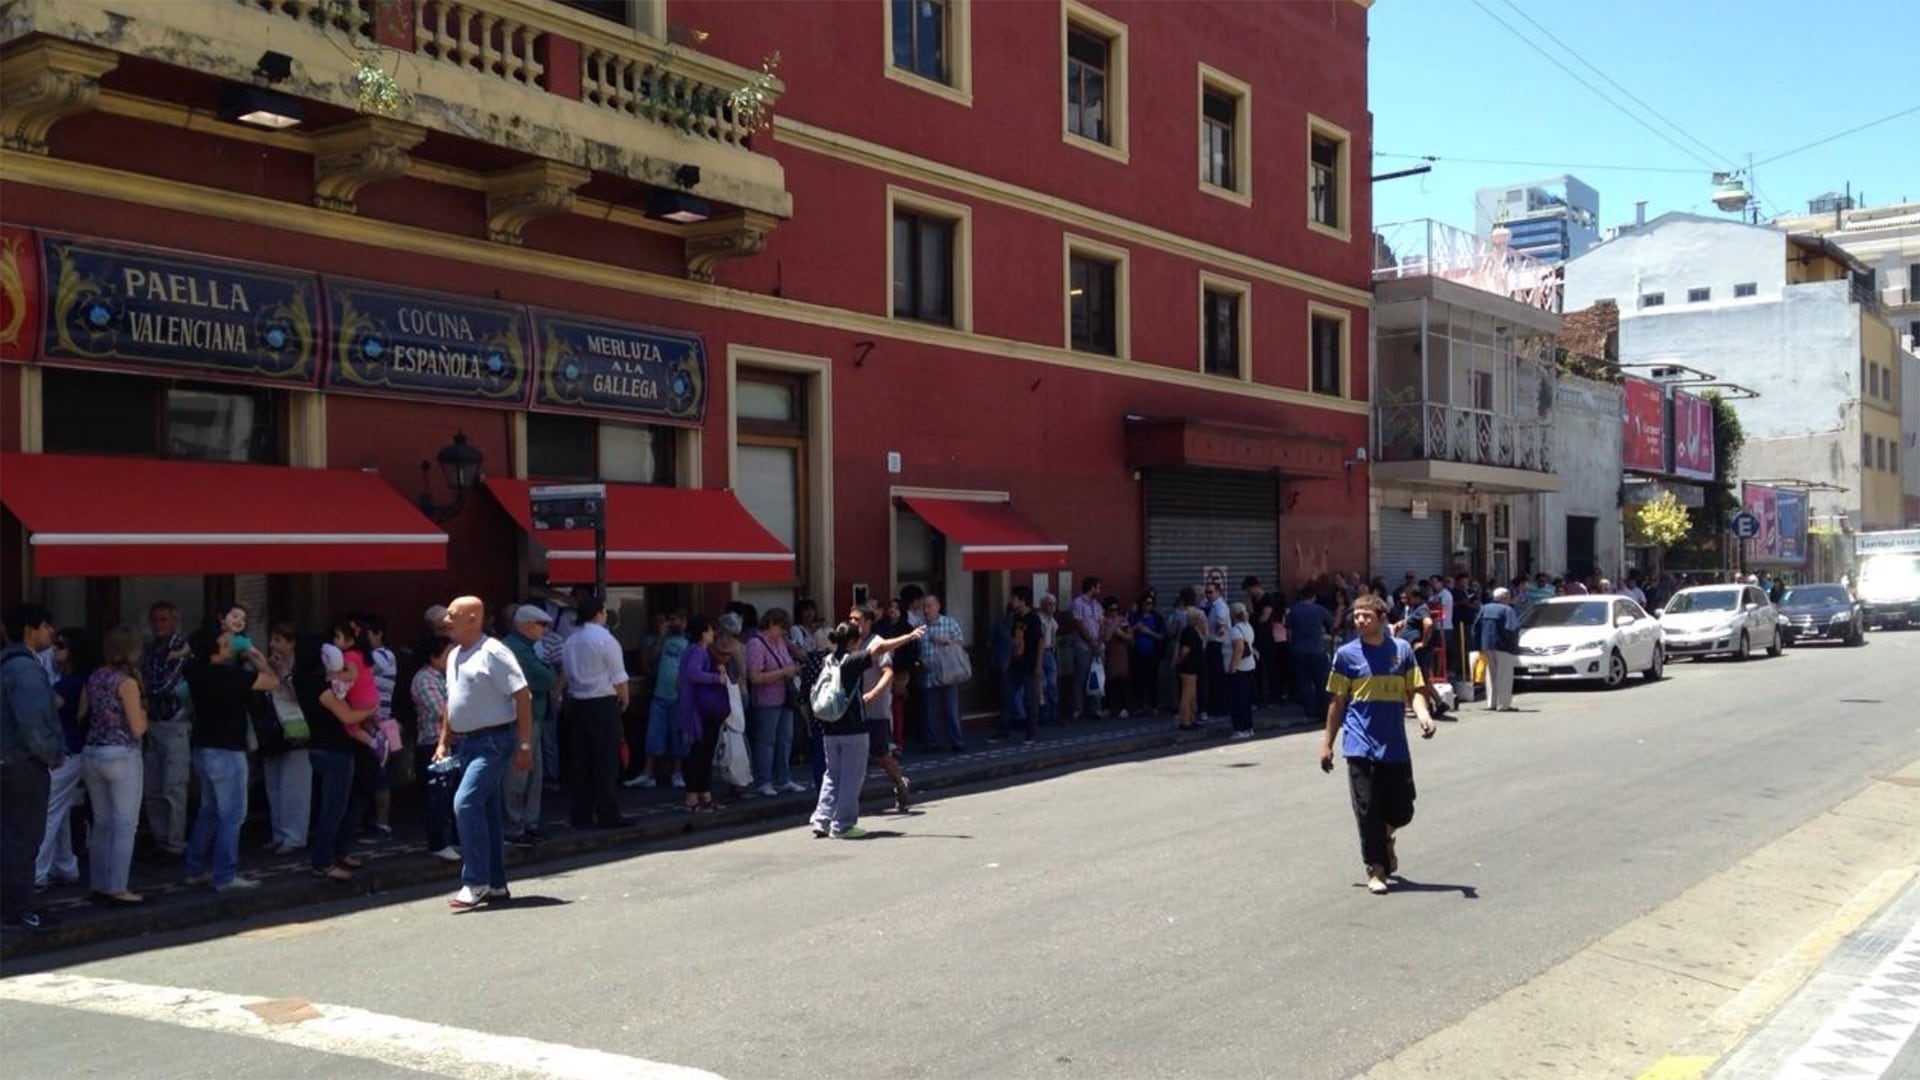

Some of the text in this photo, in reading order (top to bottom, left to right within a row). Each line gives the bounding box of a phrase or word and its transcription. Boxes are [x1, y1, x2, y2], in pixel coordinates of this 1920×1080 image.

[123, 267, 250, 312] PAELLA
[129, 311, 248, 353] VALENCIANA
[398, 307, 475, 342] COCINA
[393, 344, 482, 380] ESPAÑOLA
[588, 334, 662, 363] MERLUZA
[611, 361, 643, 374] A LA
[593, 373, 658, 400] GALLEGA
[1738, 517, 1752, 536] E
